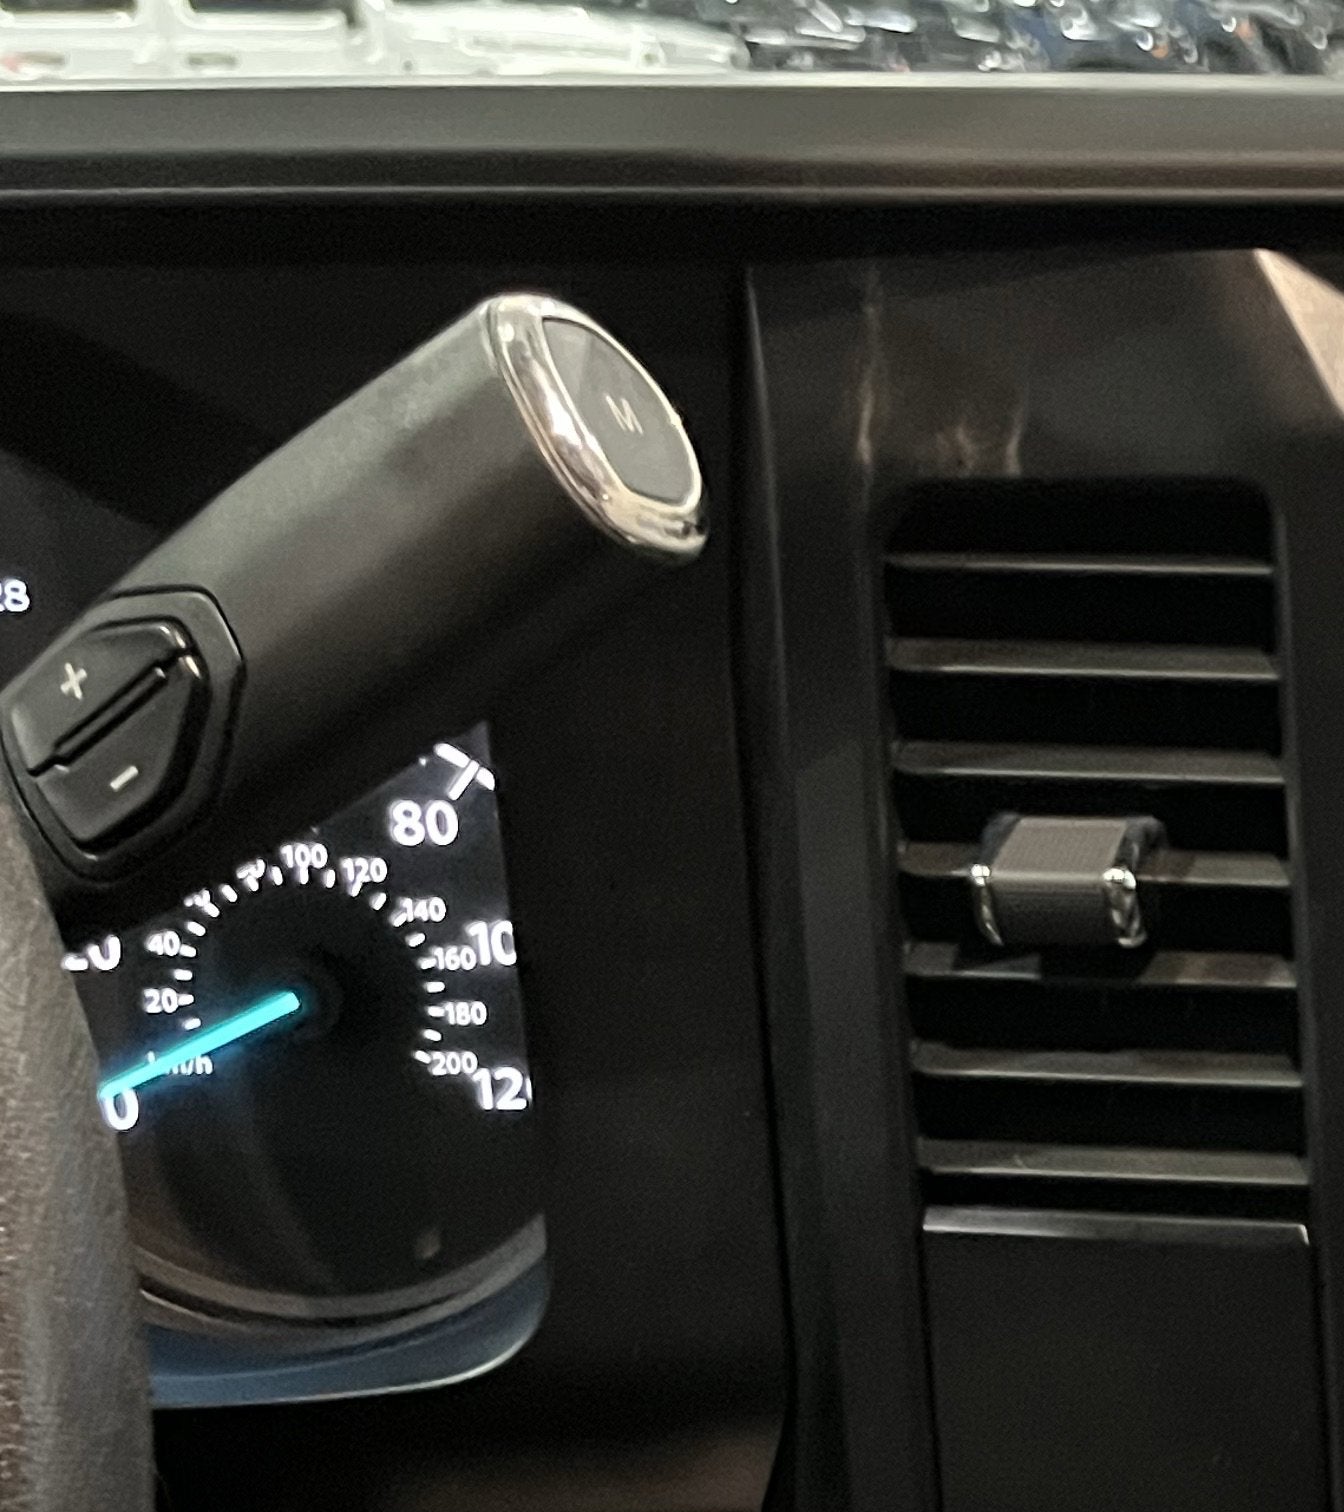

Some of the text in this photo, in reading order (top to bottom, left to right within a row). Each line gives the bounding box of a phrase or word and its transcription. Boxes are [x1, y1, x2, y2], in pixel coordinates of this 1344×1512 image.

[390, 801, 458, 846] 80
[281, 843, 328, 867] 100
[343, 858, 387, 883] 120
[404, 897, 446, 923] 140
[146, 931, 180, 957] 40
[434, 946, 477, 971] 160
[143, 987, 178, 1014] 20
[445, 1001, 487, 1026] 180
[431, 1050, 476, 1076] 200
